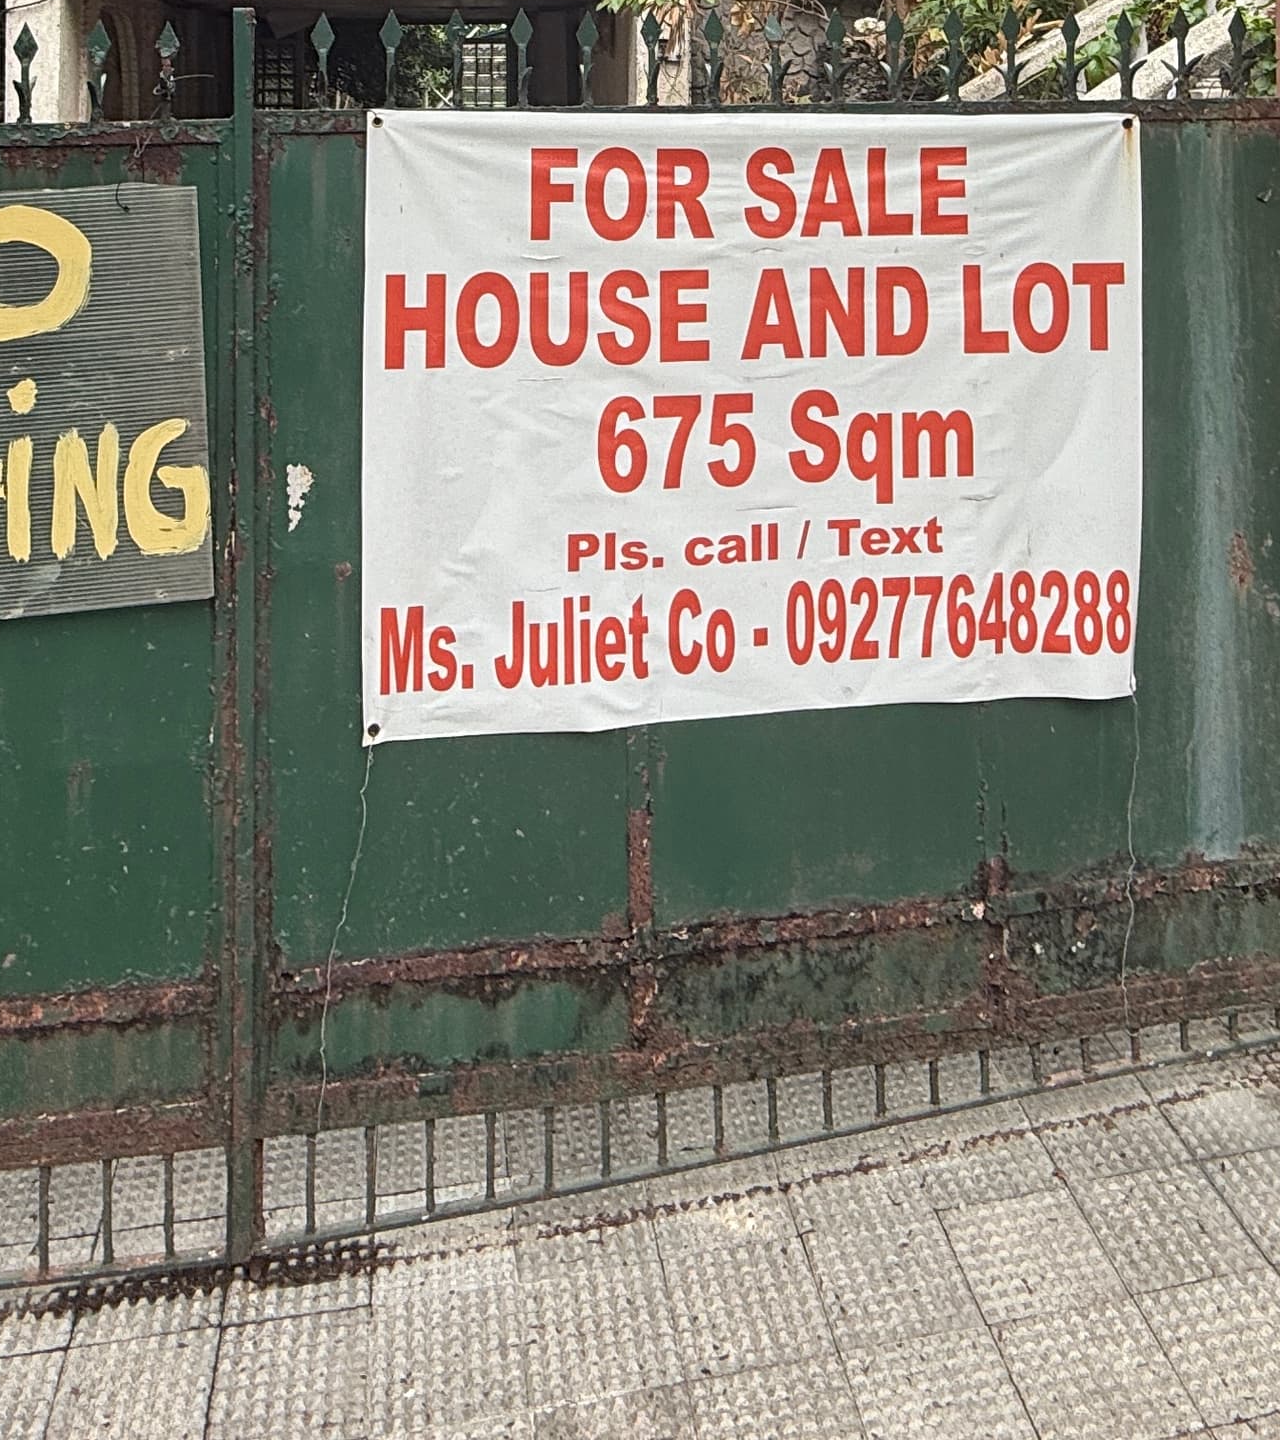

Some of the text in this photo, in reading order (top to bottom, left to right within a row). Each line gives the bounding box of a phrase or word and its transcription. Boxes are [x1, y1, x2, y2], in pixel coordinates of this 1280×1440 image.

[529, 146, 969, 242] FOR SALE
[383, 261, 1126, 371] HOUSE AND LOT
[596, 388, 975, 505] 675 Sqm
[567, 516, 944, 573] Pls. call / Text
[379, 569, 1132, 696] Ms. Juliet Co - 09277648288
